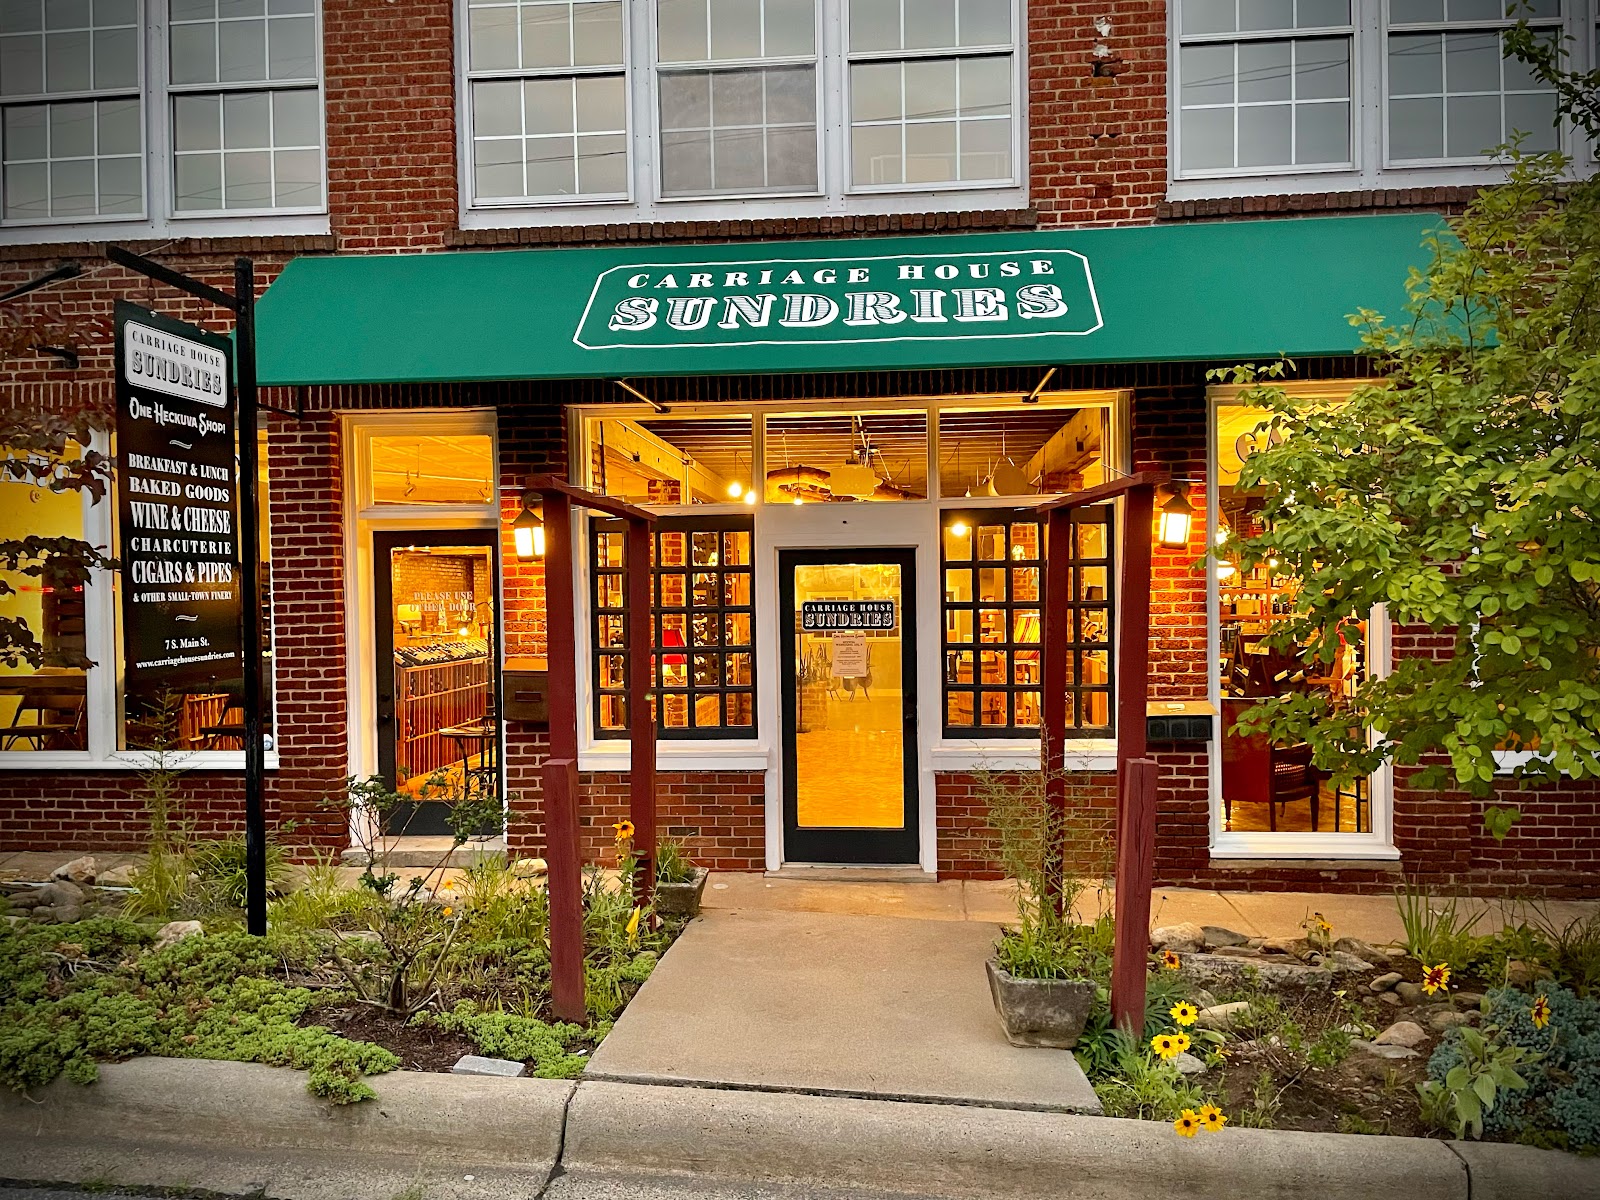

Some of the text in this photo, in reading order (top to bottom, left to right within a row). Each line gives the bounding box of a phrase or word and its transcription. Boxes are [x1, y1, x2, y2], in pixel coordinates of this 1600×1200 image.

[626, 258, 1056, 290] CARRIAGE HOUSE
[606, 283, 1071, 332] SUNDRIES
[132, 330, 220, 367] CARRIAGE HOUSE
[132, 349, 222, 395] SUNDRIES
[128, 453, 229, 482] BREAKFAST & LUNCH
[128, 476, 230, 503] BAKED GOODS
[129, 501, 231, 534] WINE & CHEESE
[131, 537, 232, 555] CHARCUTERIE
[131, 560, 232, 584] CIGARS & PIPES
[133, 590, 232, 603] & OTHER SMALL-TOWN FINERY
[414, 591, 473, 601] PLEASE USE
[410, 602, 477, 612] OTHER DOOR
[804, 604, 892, 612] CARRIAGE HOUSE
[804, 612, 893, 627] SUNDRIES
[165, 636, 210, 650] 7 S. Main St.
[136, 652, 235, 669] www.carriagehousesundries.com
